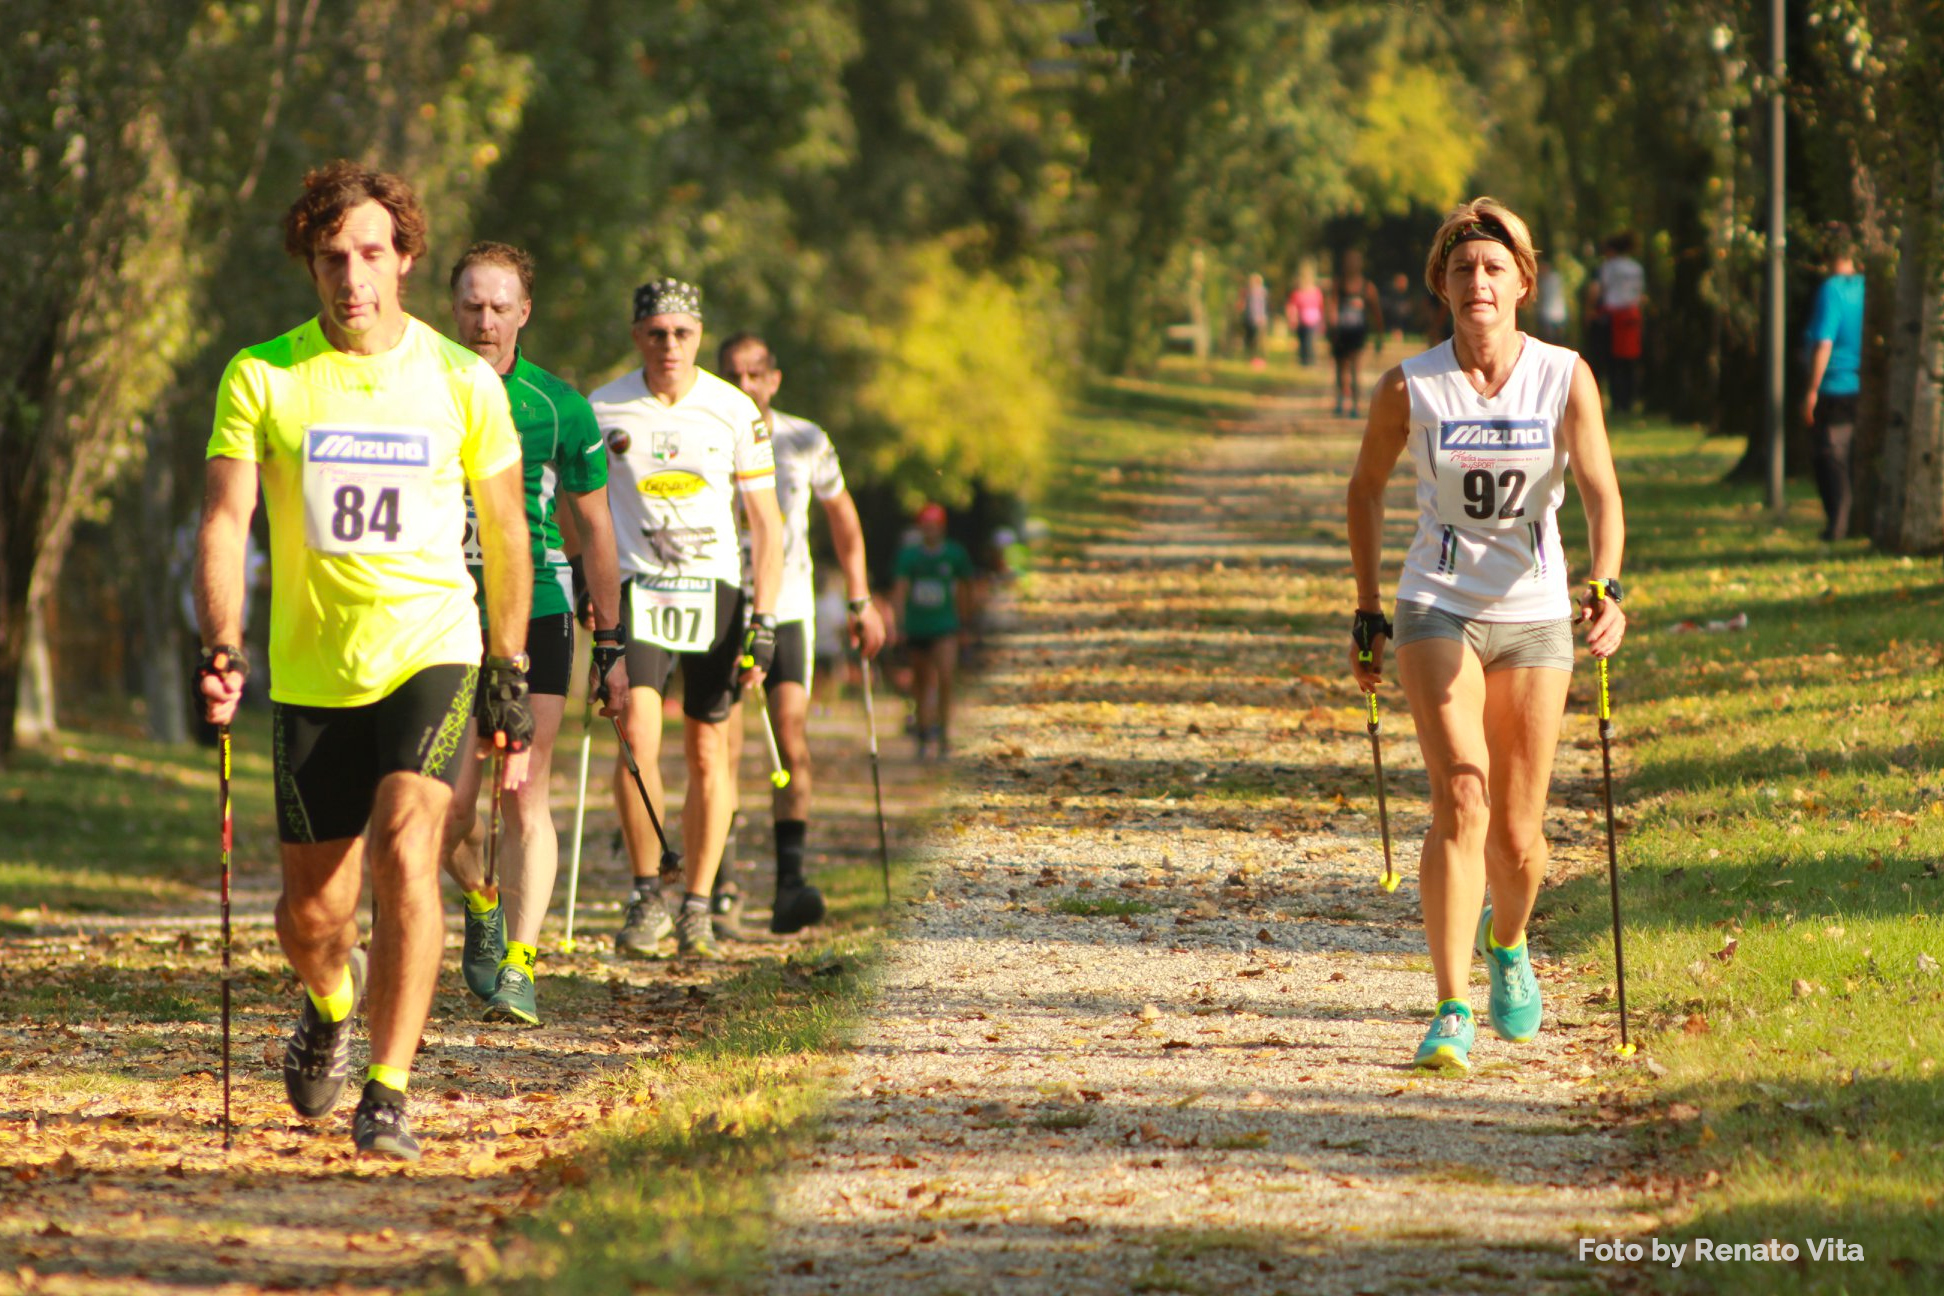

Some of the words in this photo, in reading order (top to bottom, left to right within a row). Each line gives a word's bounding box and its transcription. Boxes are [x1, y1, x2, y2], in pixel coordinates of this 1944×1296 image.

[331, 484, 402, 542] 84
[1463, 468, 1527, 520] 92
[645, 606, 703, 643] 107
